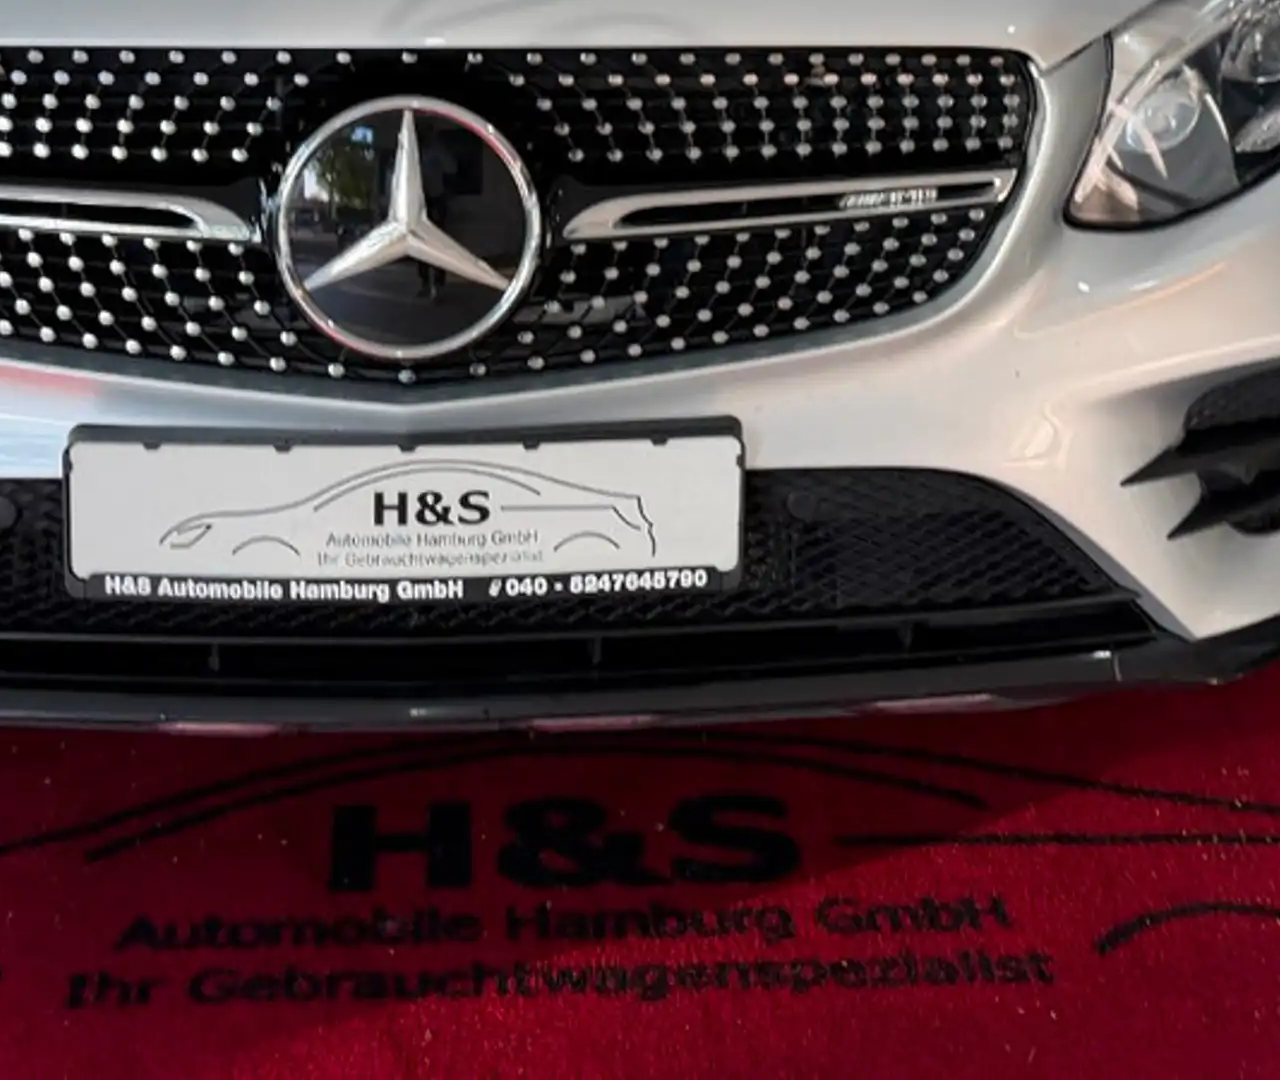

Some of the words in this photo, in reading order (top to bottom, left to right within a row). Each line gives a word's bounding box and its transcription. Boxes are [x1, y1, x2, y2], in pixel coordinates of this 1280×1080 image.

[373, 490, 491, 527] H&S
[325, 532, 412, 548] Automobile
[416, 531, 487, 549] Hamburg
[491, 530, 539, 545] GmbH
[157, 577, 284, 600] Automobile
[289, 579, 390, 603] Hamburg
[397, 580, 464, 600] GmbH
[506, 575, 548, 597] 040
[328, 794, 801, 892] H&S
[115, 904, 483, 952] Automobile
[506, 900, 796, 944] Hamburg
[816, 894, 1013, 934] GmbH
[64, 970, 166, 1009] Ihr
[189, 950, 1054, 1001] Gebrauchtwagenspezialist
